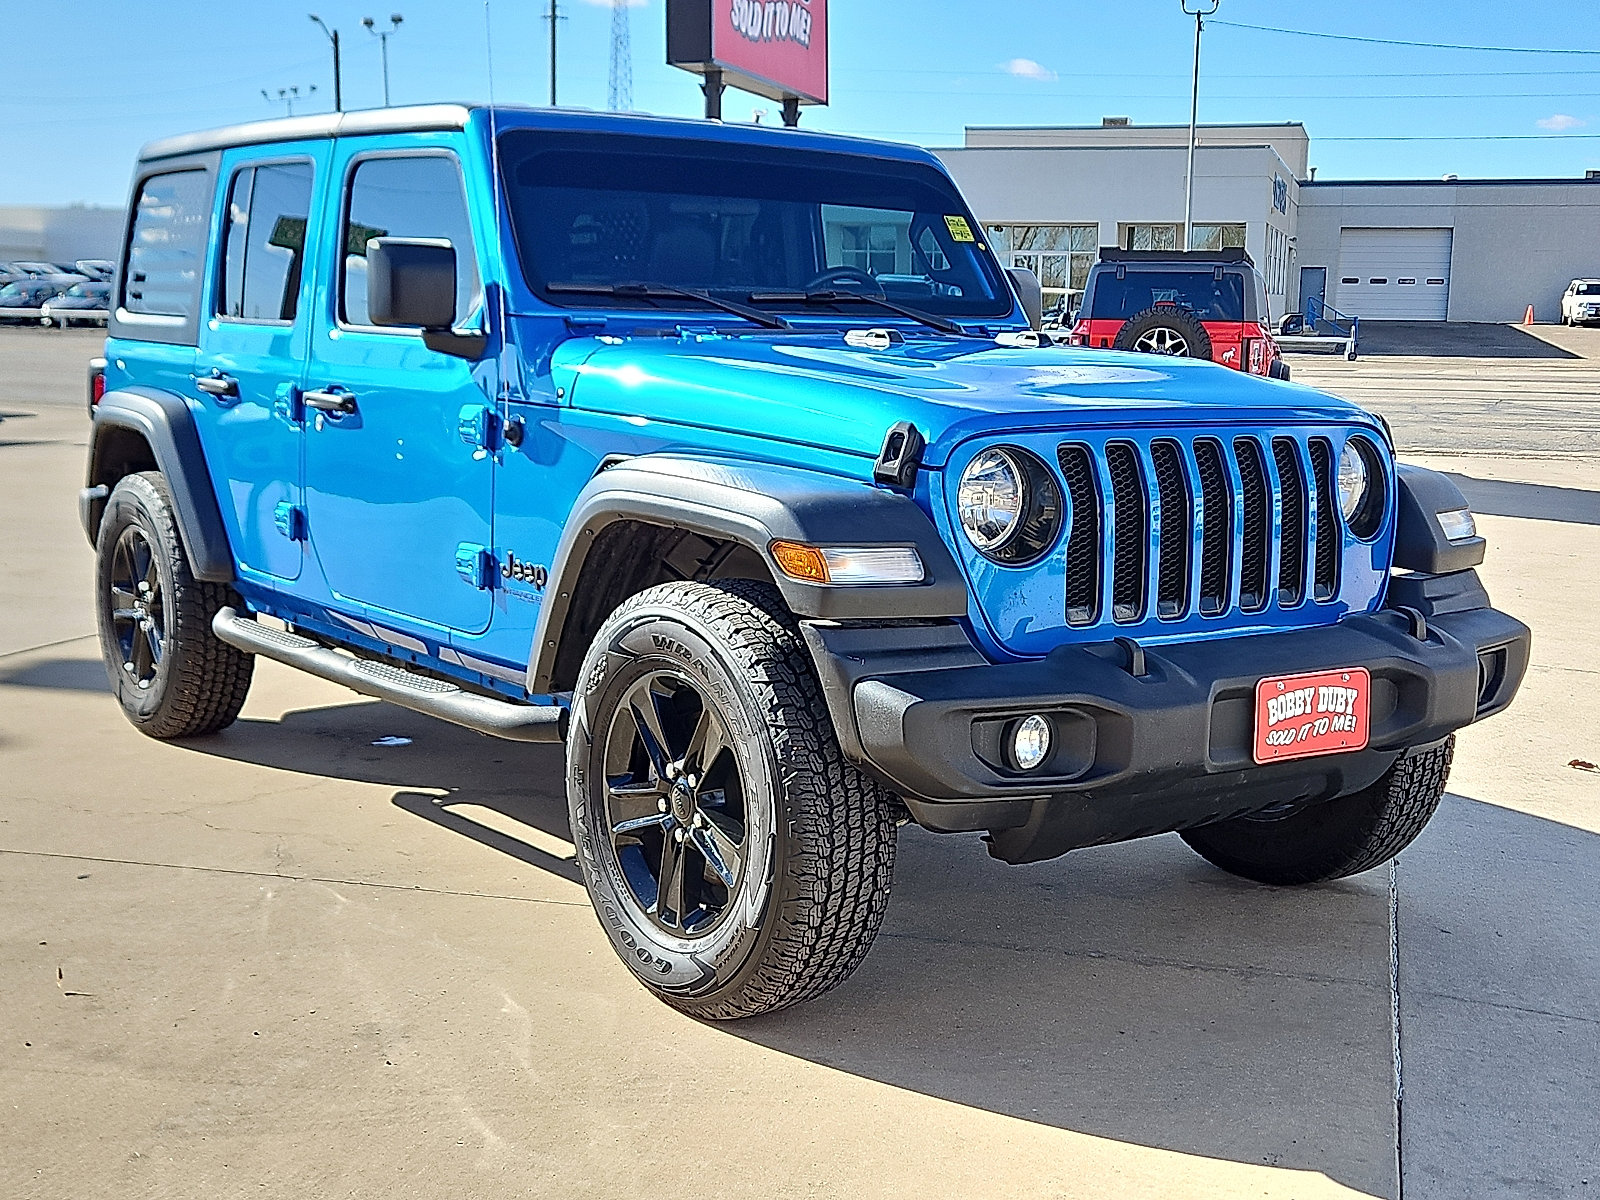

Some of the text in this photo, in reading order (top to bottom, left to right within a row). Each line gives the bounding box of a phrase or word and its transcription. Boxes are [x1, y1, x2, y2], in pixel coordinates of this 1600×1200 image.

[730, 0, 811, 49] SOLD IT TO ME!
[499, 549, 548, 591] Jeep
[1267, 685, 1358, 727] BOBBY DUBY
[1265, 714, 1357, 746] SOLD IT TO ME!
[573, 764, 673, 976] GOODYEAR
